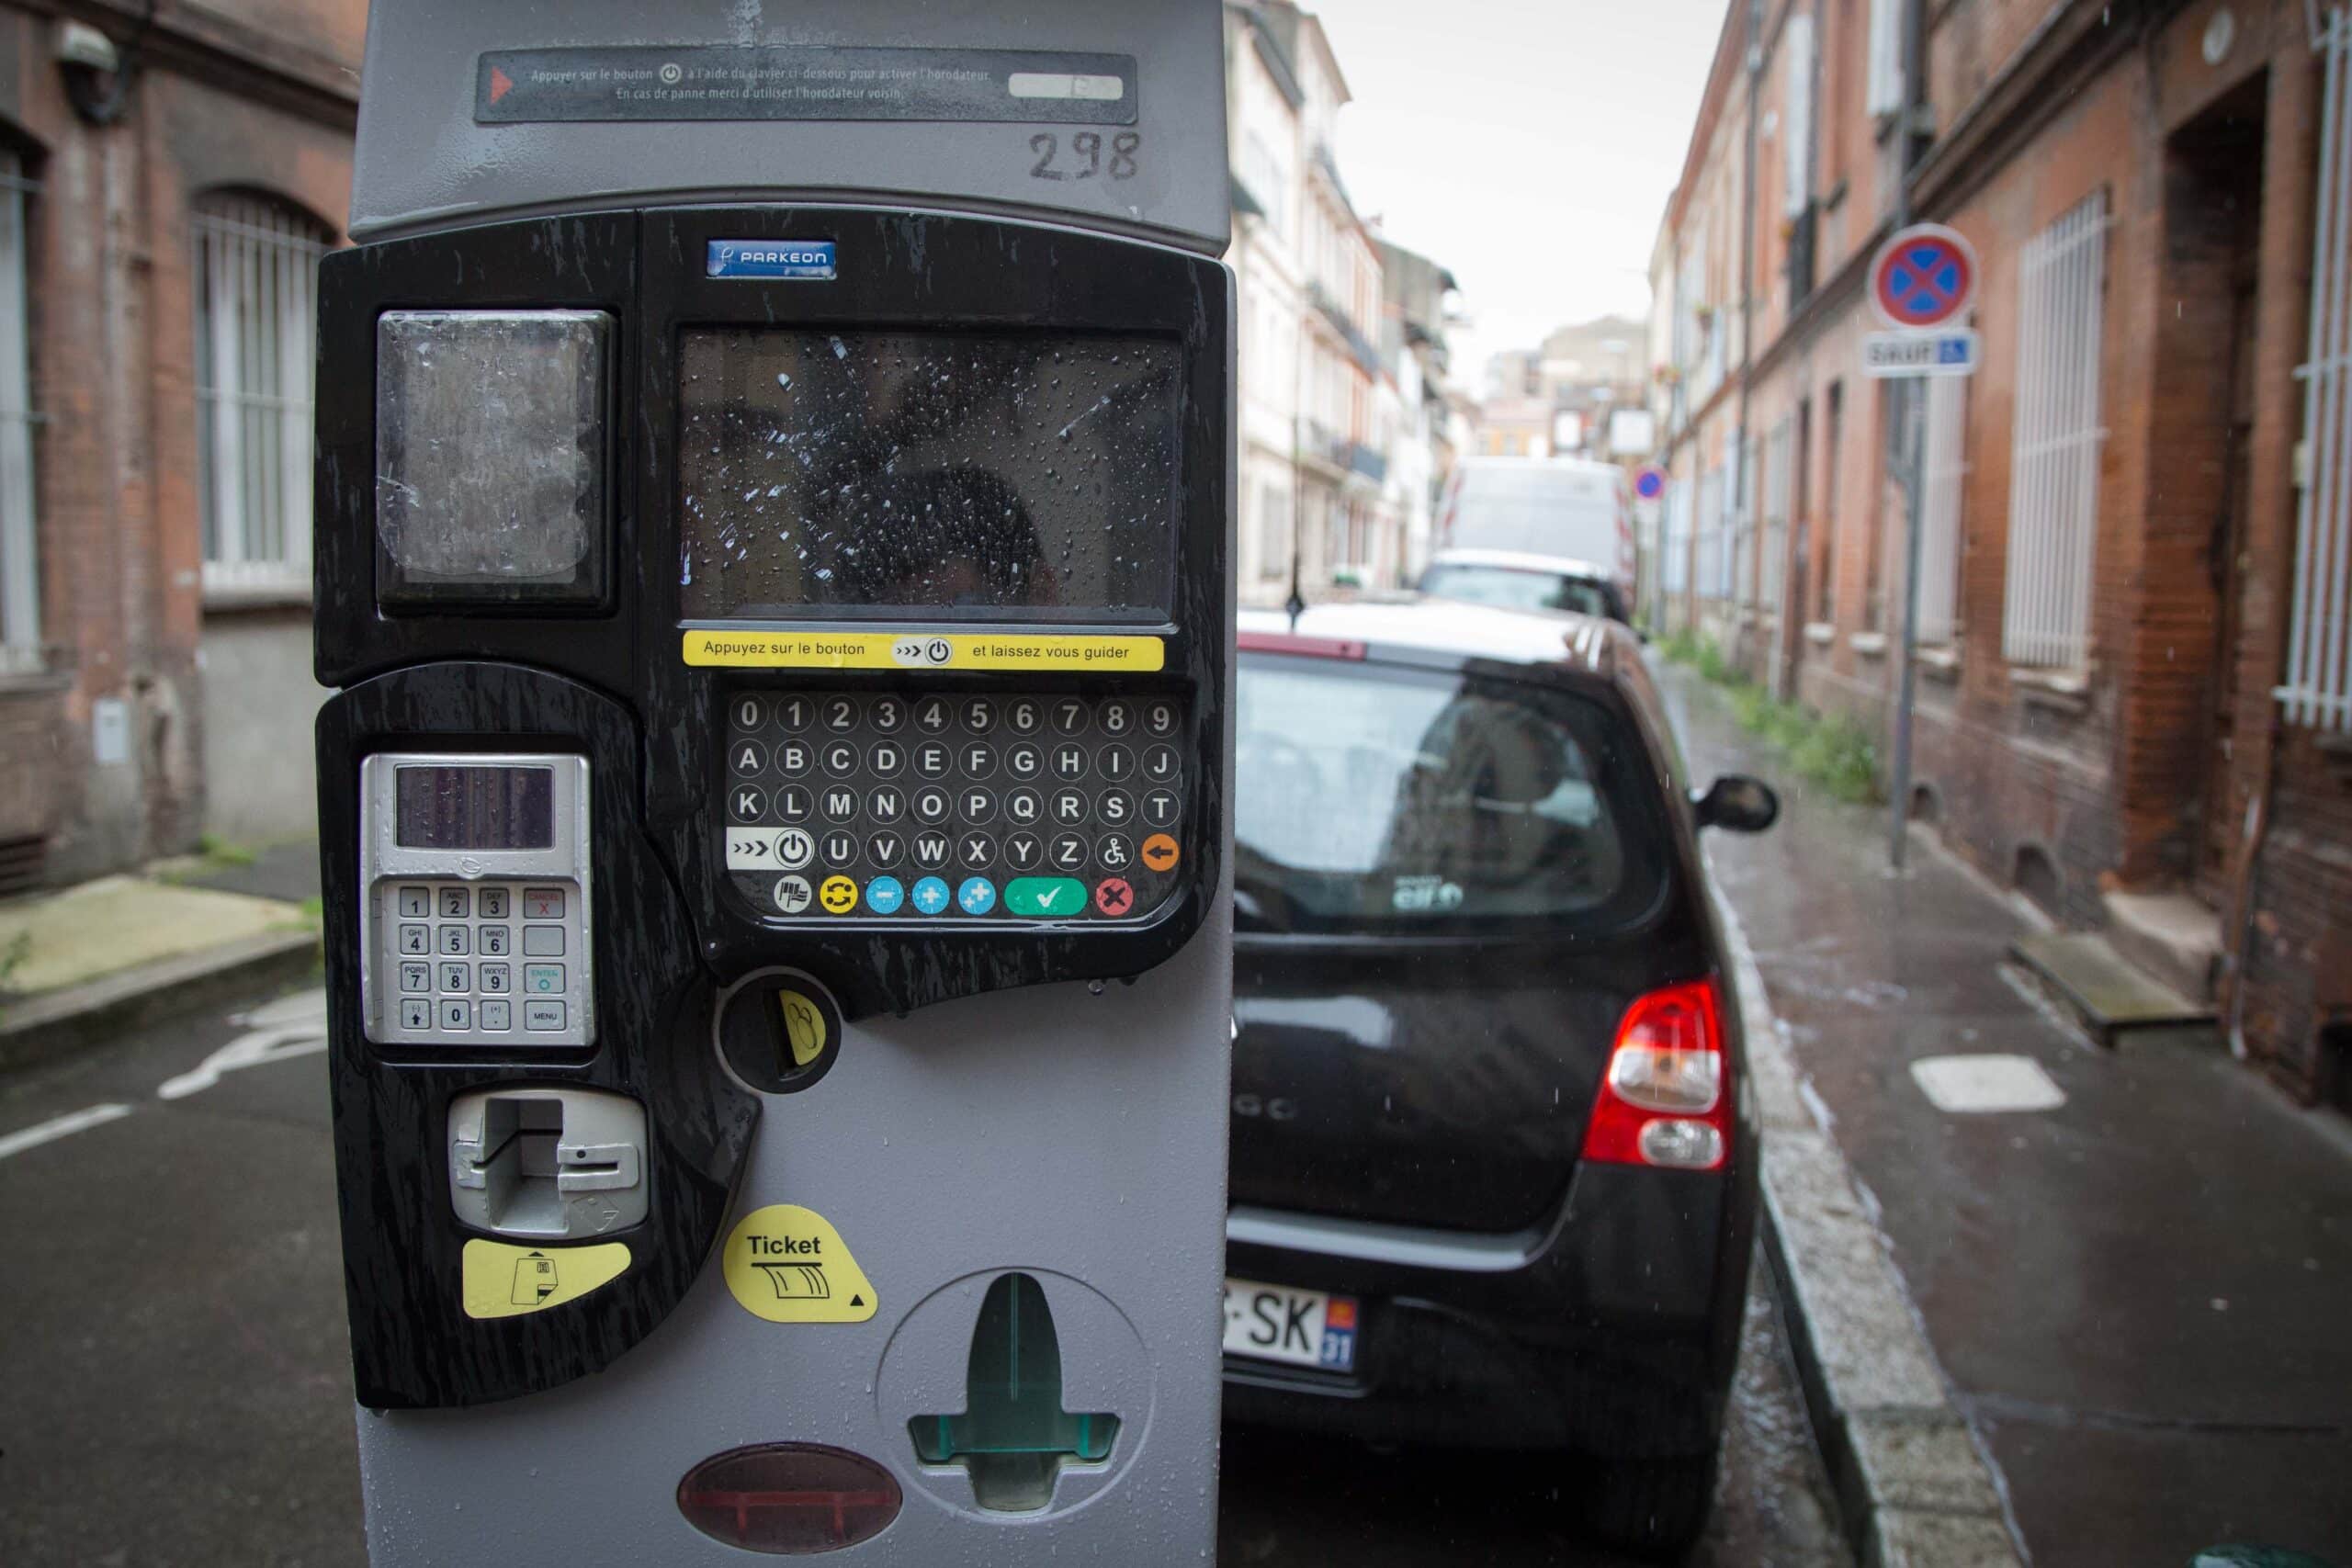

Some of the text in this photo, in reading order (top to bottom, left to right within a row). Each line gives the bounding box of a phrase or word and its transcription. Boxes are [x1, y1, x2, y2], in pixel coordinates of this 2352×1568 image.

[531, 70, 576, 83] Appuyer
[581, 71, 596, 80] sur
[600, 69, 610, 80] le
[614, 69, 653, 80] bouton
[731, 67, 744, 80] du
[749, 67, 785, 80] clavier
[789, 67, 847, 80] ci-dessous
[850, 70, 875, 81] pour
[878, 69, 917, 80] activer
[616, 88, 629, 99] En
[633, 89, 650, 100] cas
[654, 87, 668, 99] de
[671, 89, 706, 101] panne
[708, 87, 740, 99] merci
[1028, 131, 1139, 181] 298
[740, 252, 827, 264] PARKEON
[703, 640, 1130, 660] Appuyez sur le bouton et laissez vous guider
[788, 702, 800, 727] 1
[832, 703, 849, 727] 2
[878, 703, 896, 728] 3
[923, 704, 942, 728] 4
[970, 704, 988, 728] 5
[1016, 705, 1034, 729] 6
[1063, 705, 1078, 729] 7
[1107, 706, 1125, 730] 8
[1153, 707, 1170, 731] 9
[739, 748, 1167, 773] A B C D E F G H I J
[740, 793, 1170, 818] K L M N O P Q R S T
[831, 839, 1078, 863] U V W X Y Z
[411, 899, 419, 914] 1
[449, 900, 460, 915] 2
[490, 901, 500, 915] 3
[410, 938, 500, 953] 4 5 6
[404, 966, 427, 975] PQRS
[484, 967, 507, 976] WXYZ
[411, 975, 421, 987] 7
[450, 975, 460, 989] 8
[490, 976, 501, 989] 9
[451, 1009, 558, 1022] 0 MENU
[746, 1235, 822, 1255] Ticket
[1323, 1332, 1352, 1364] 31
